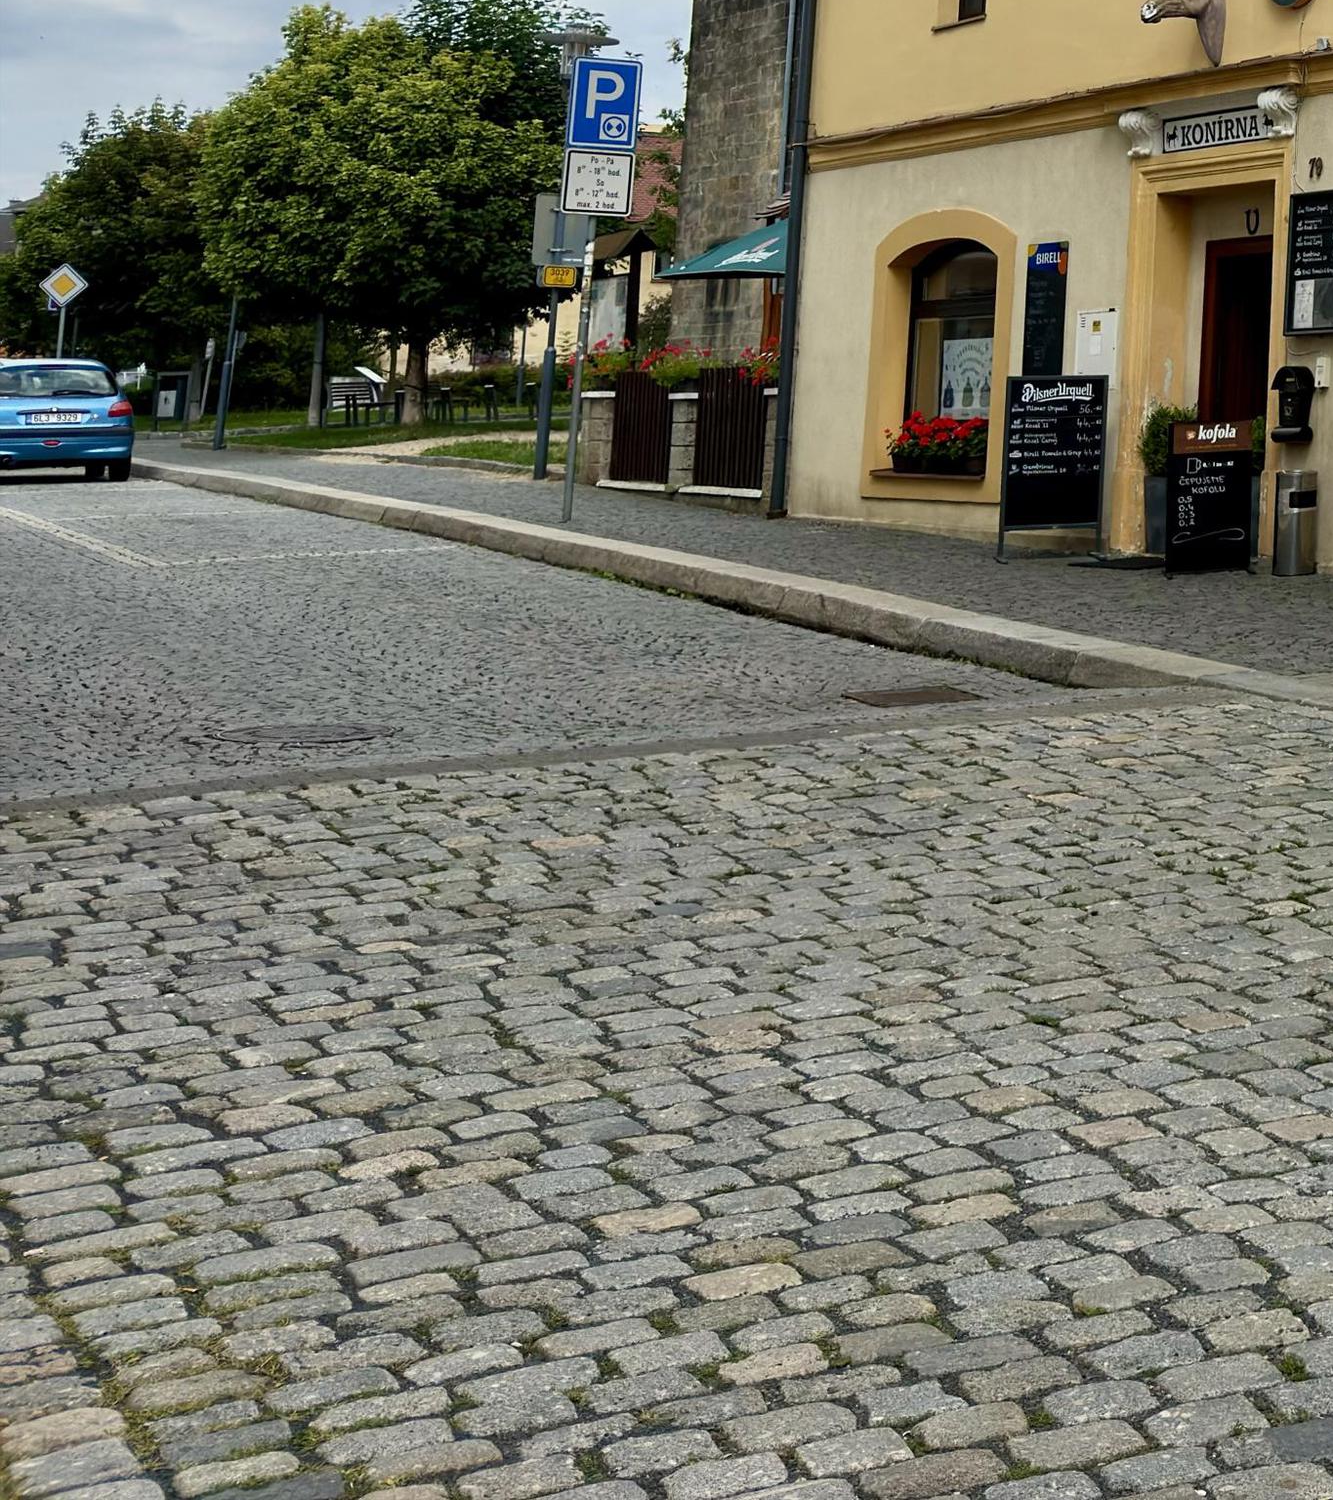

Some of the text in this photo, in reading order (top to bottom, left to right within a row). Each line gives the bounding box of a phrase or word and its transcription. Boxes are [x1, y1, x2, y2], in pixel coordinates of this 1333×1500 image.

[585, 69, 625, 119] P
[1181, 115, 1260, 147] KONÍRNA
[1036, 251, 1062, 265] BIRELL
[1021, 382, 1093, 403] Pilsner Urquell
[56, 413, 78, 422] 9329
[1198, 423, 1237, 444] kofola
[1191, 485, 1226, 494] KOFOLU
